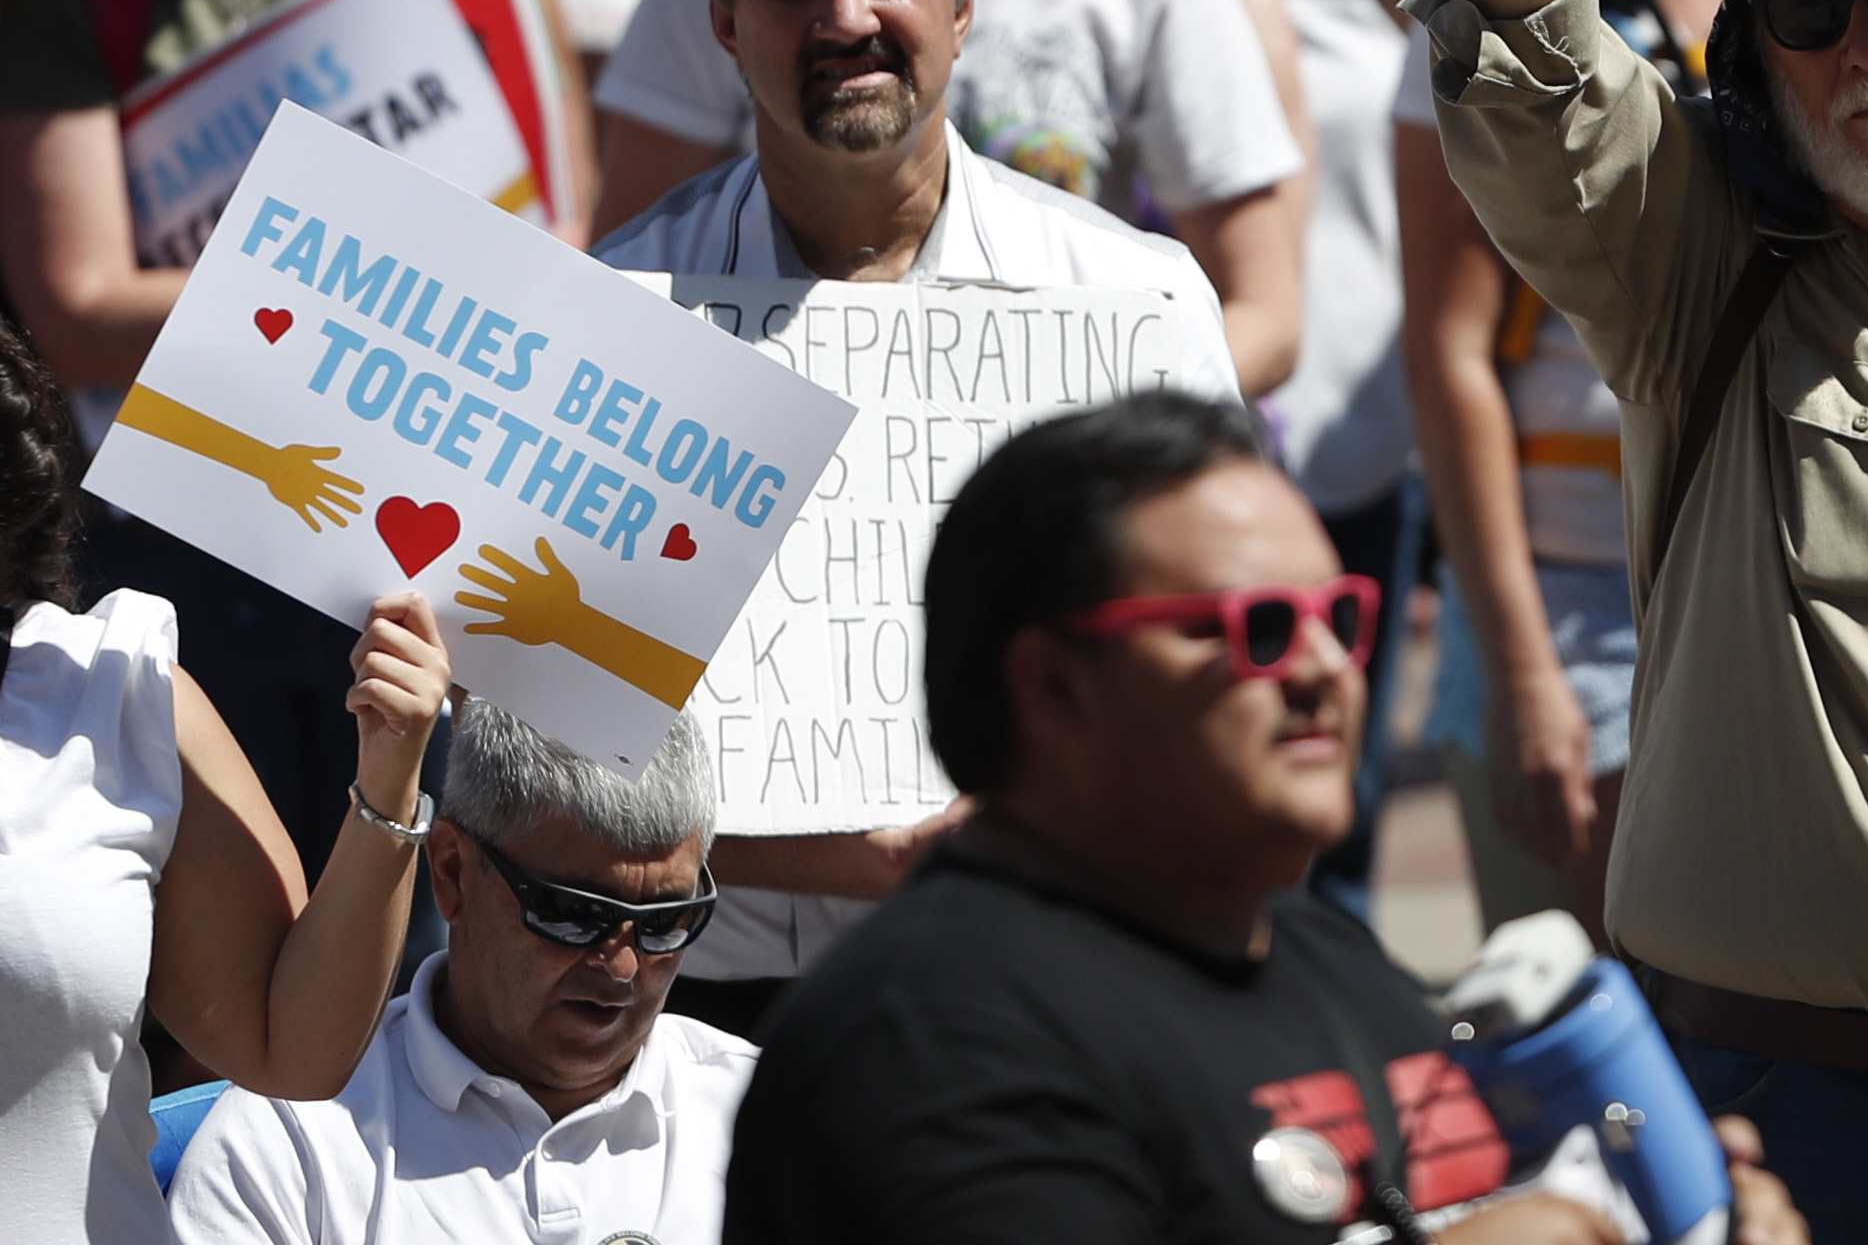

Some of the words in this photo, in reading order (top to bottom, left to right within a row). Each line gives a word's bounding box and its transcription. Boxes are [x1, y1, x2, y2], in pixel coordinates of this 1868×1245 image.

[346, 69, 460, 148] TAR
[241, 196, 549, 392] FAMILIES
[554, 358, 786, 528] BELONG
[309, 319, 657, 561] TOGETHER
[776, 517, 940, 605] CHIL
[828, 618, 909, 705] TO
[719, 715, 944, 805] FAMIL
